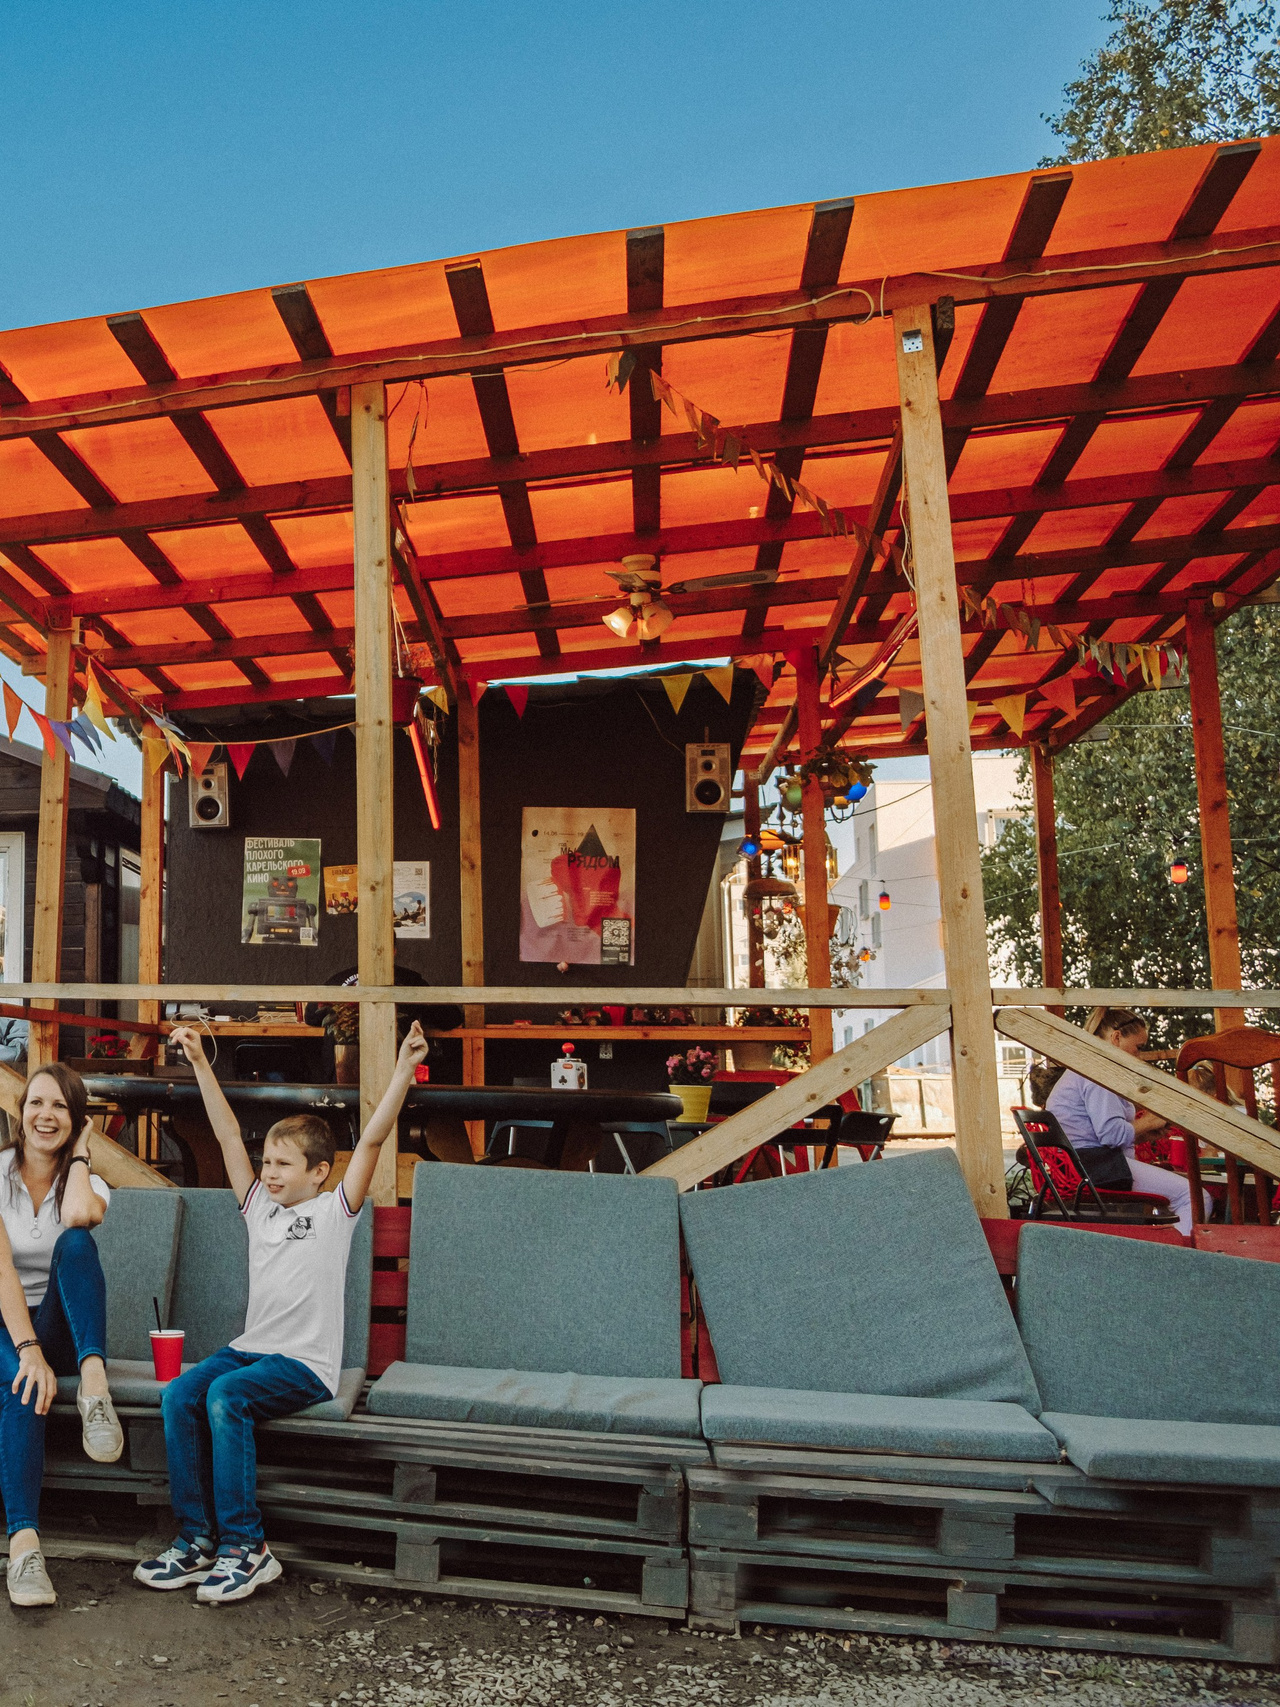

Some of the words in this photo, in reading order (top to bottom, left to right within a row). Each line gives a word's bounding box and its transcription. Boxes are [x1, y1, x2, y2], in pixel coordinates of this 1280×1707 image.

[245, 839, 296, 849] ФЕСТИВАЛЬ
[245, 849, 284, 861] ПЛОХОГО
[567, 854, 620, 869] РЯДОМ
[246, 872, 270, 884] КИНО
